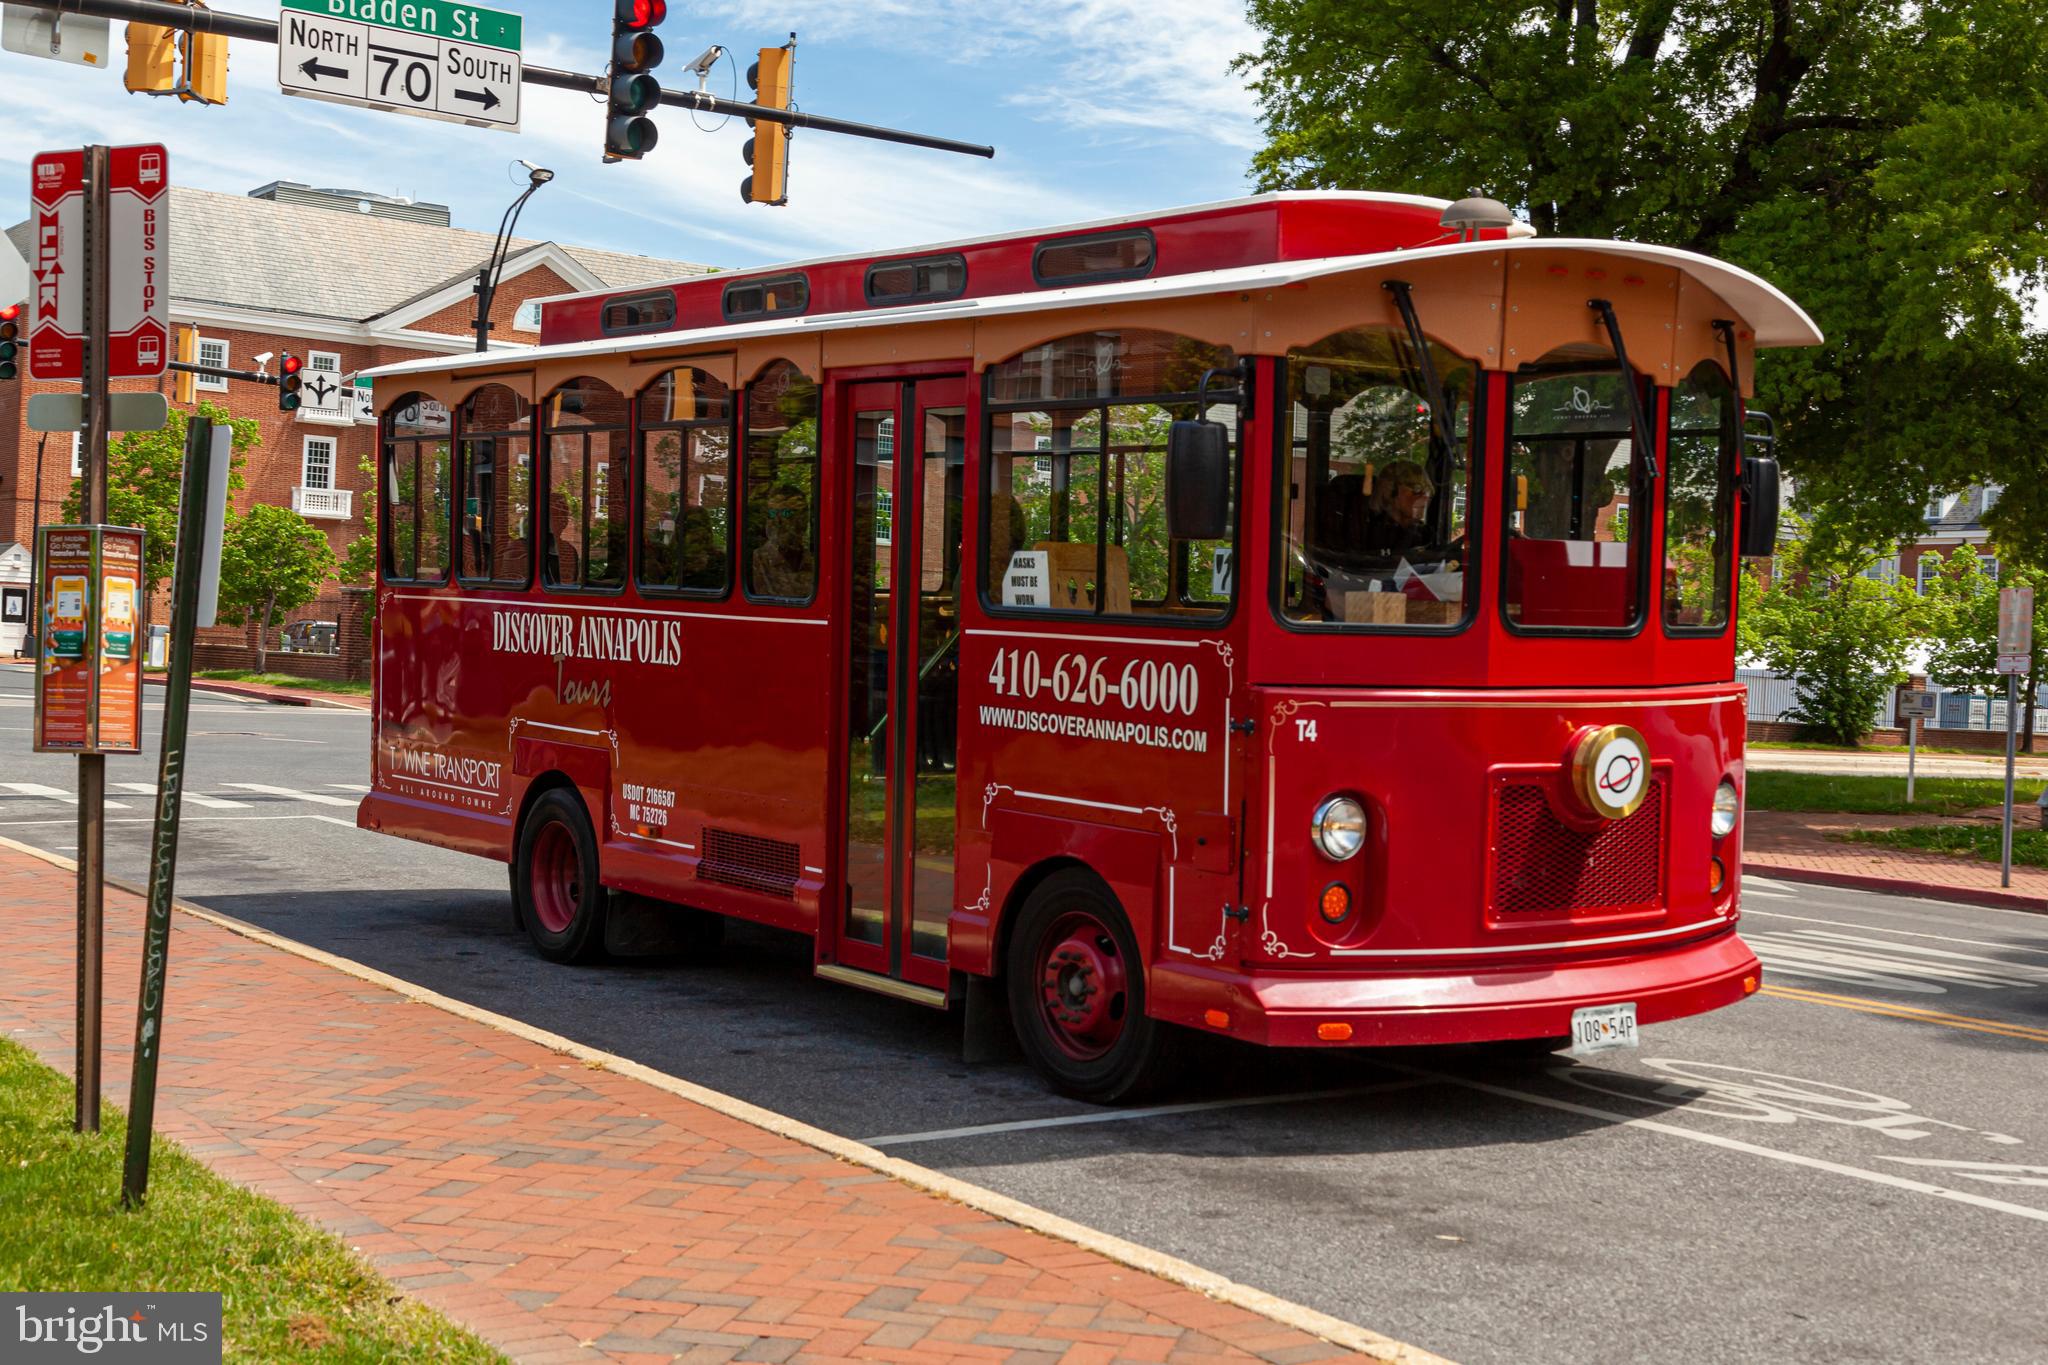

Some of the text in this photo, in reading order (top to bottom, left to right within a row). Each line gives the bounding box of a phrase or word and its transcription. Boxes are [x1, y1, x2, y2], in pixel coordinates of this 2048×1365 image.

[451, 9, 480, 40] St
[290, 18, 512, 102] NORTH 70 SOUTH
[143, 209, 155, 313] BUS STOP
[1013, 557, 1036, 569] MASKS
[1011, 575, 1038, 587] MUST BE
[1015, 594, 1035, 606] WORN
[492, 611, 682, 667] DISCOVER ANNAPOLIS
[553, 653, 612, 707] Tours
[988, 647, 1200, 717] 410-626-6000
[979, 705, 1208, 753] WWW.DISCOVERANNAPOLIS.COM
[1295, 719, 1318, 743] T4
[433, 752, 501, 789] TRANSPORT
[400, 784, 492, 809] ALL AROUND TOWNE
[622, 783, 676, 808] USDOT 2166587
[629, 803, 668, 827] MC 752726
